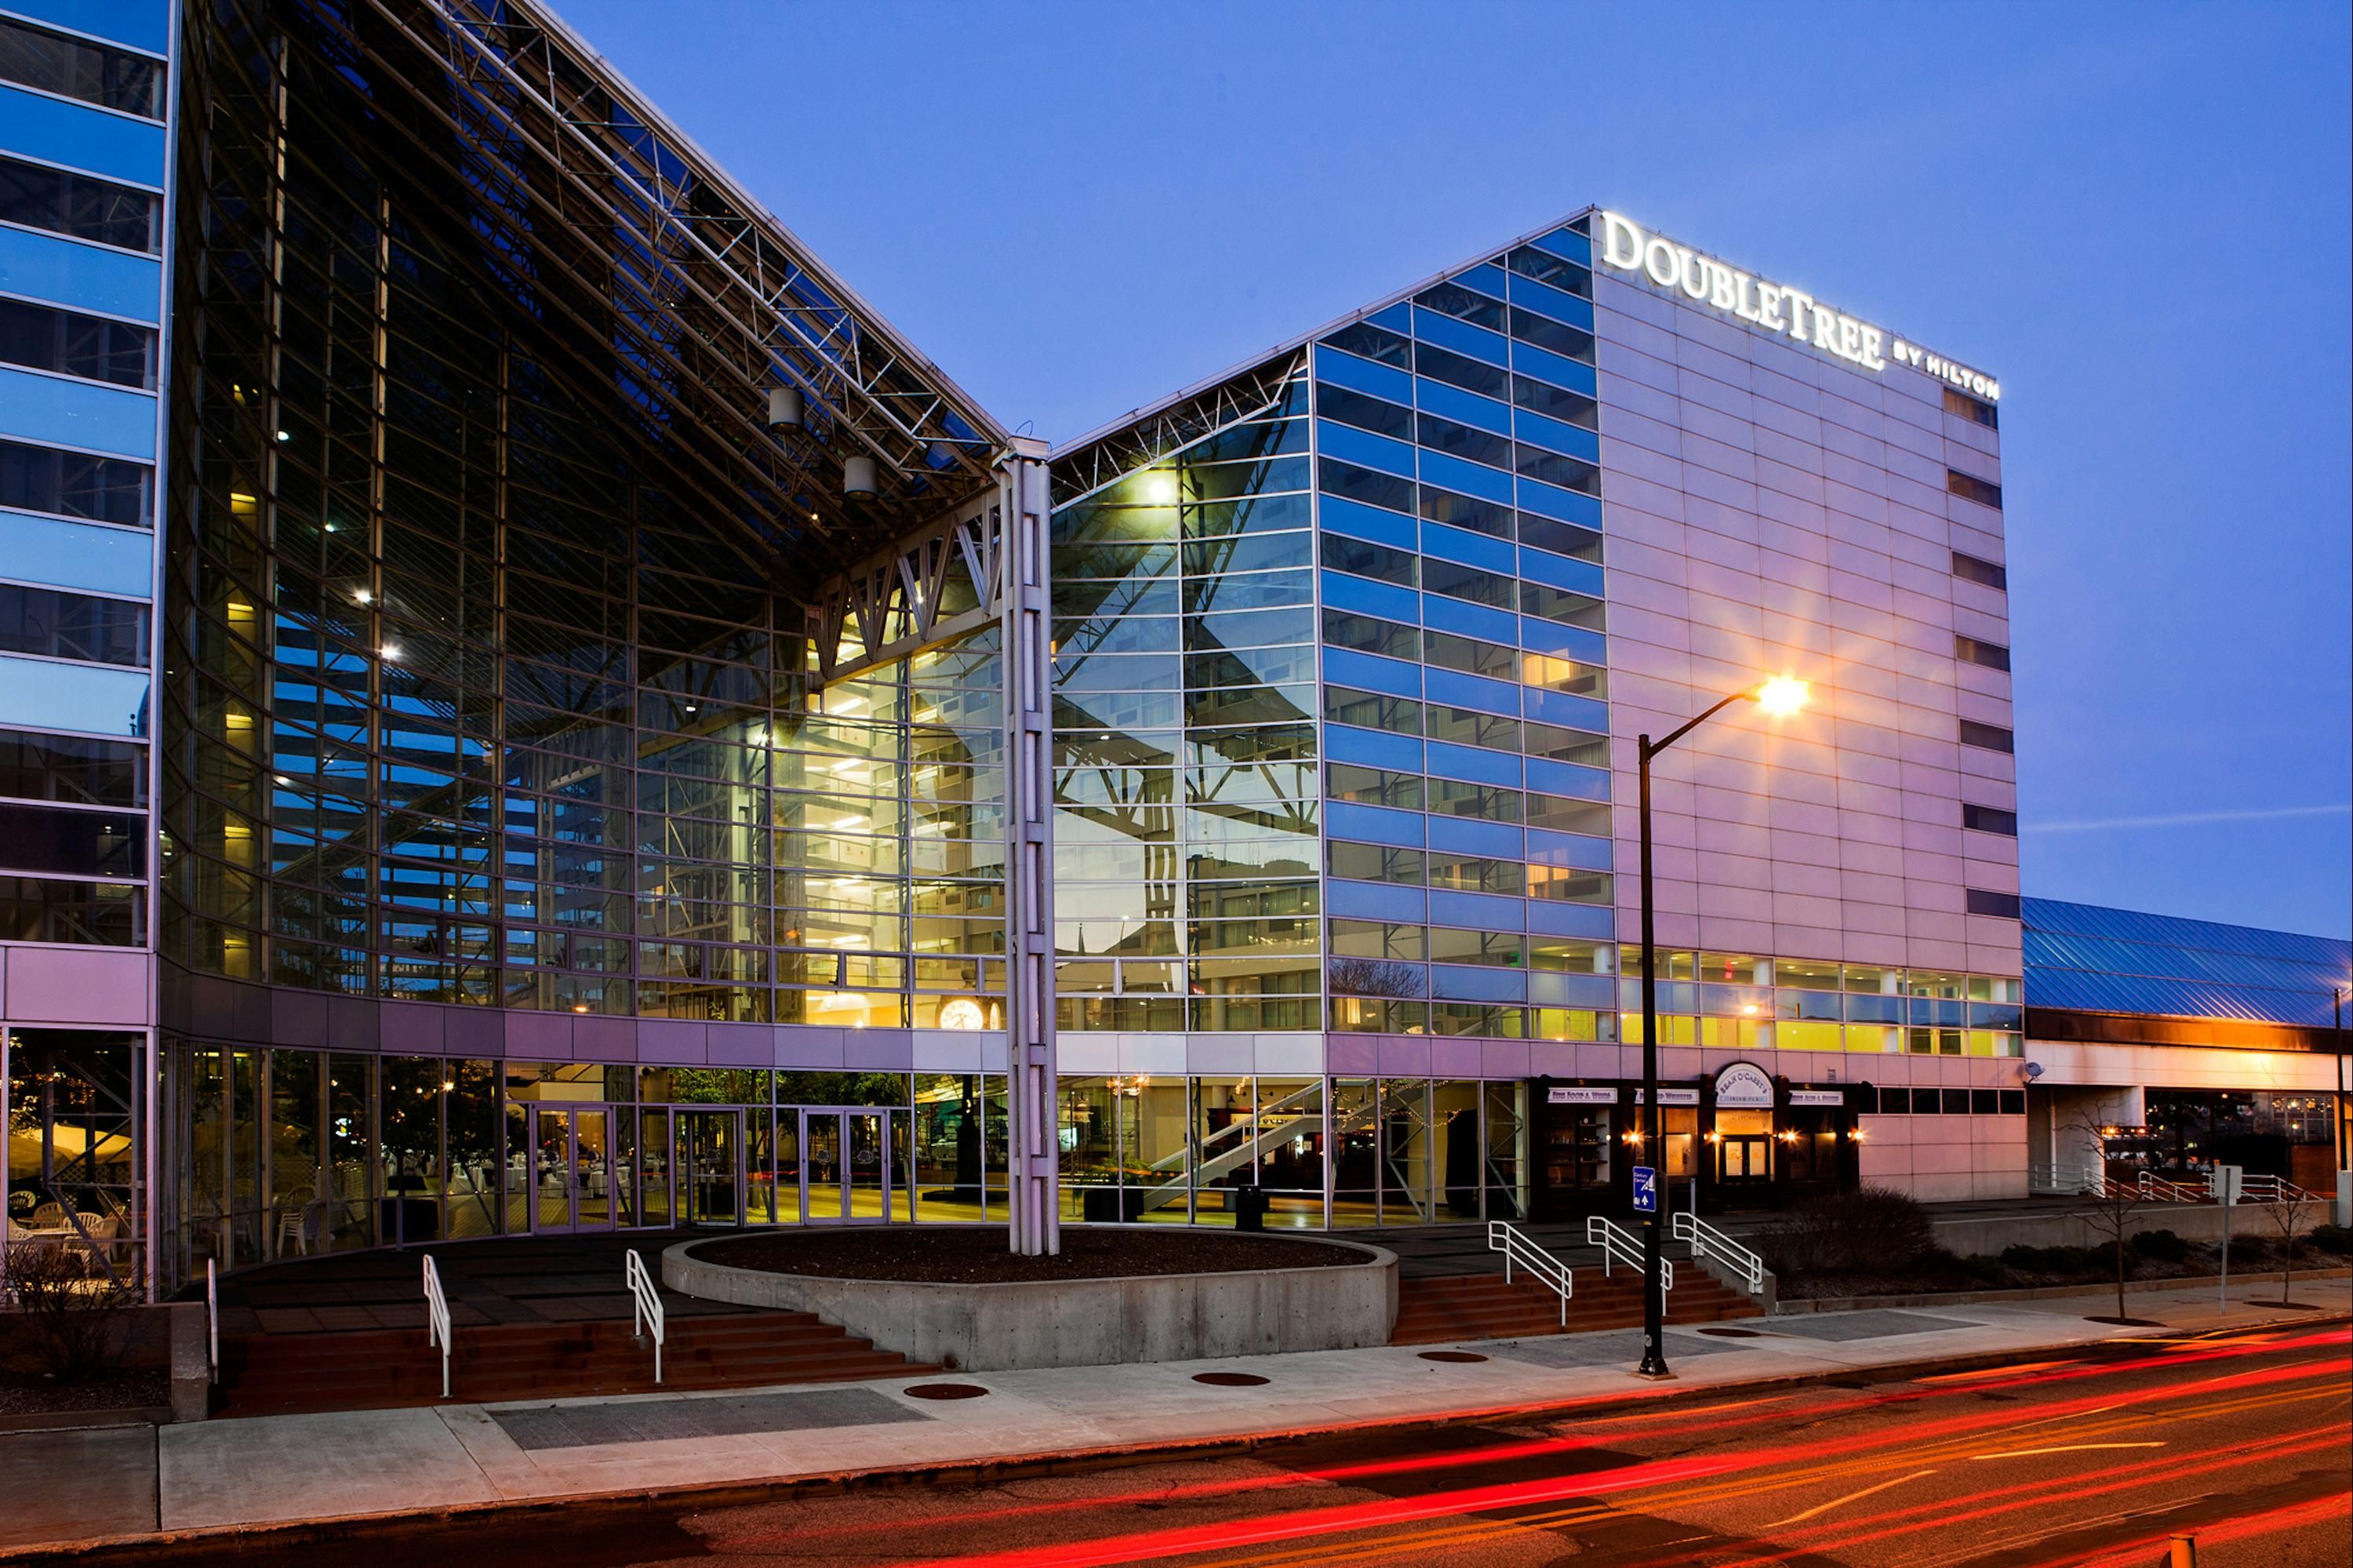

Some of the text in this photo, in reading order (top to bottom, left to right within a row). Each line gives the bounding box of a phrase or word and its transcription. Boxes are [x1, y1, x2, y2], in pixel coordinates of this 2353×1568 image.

[1893, 340, 1922, 366] BY
[1926, 355, 1999, 401] HILTON
[1720, 1075, 1738, 1094] SEAN
